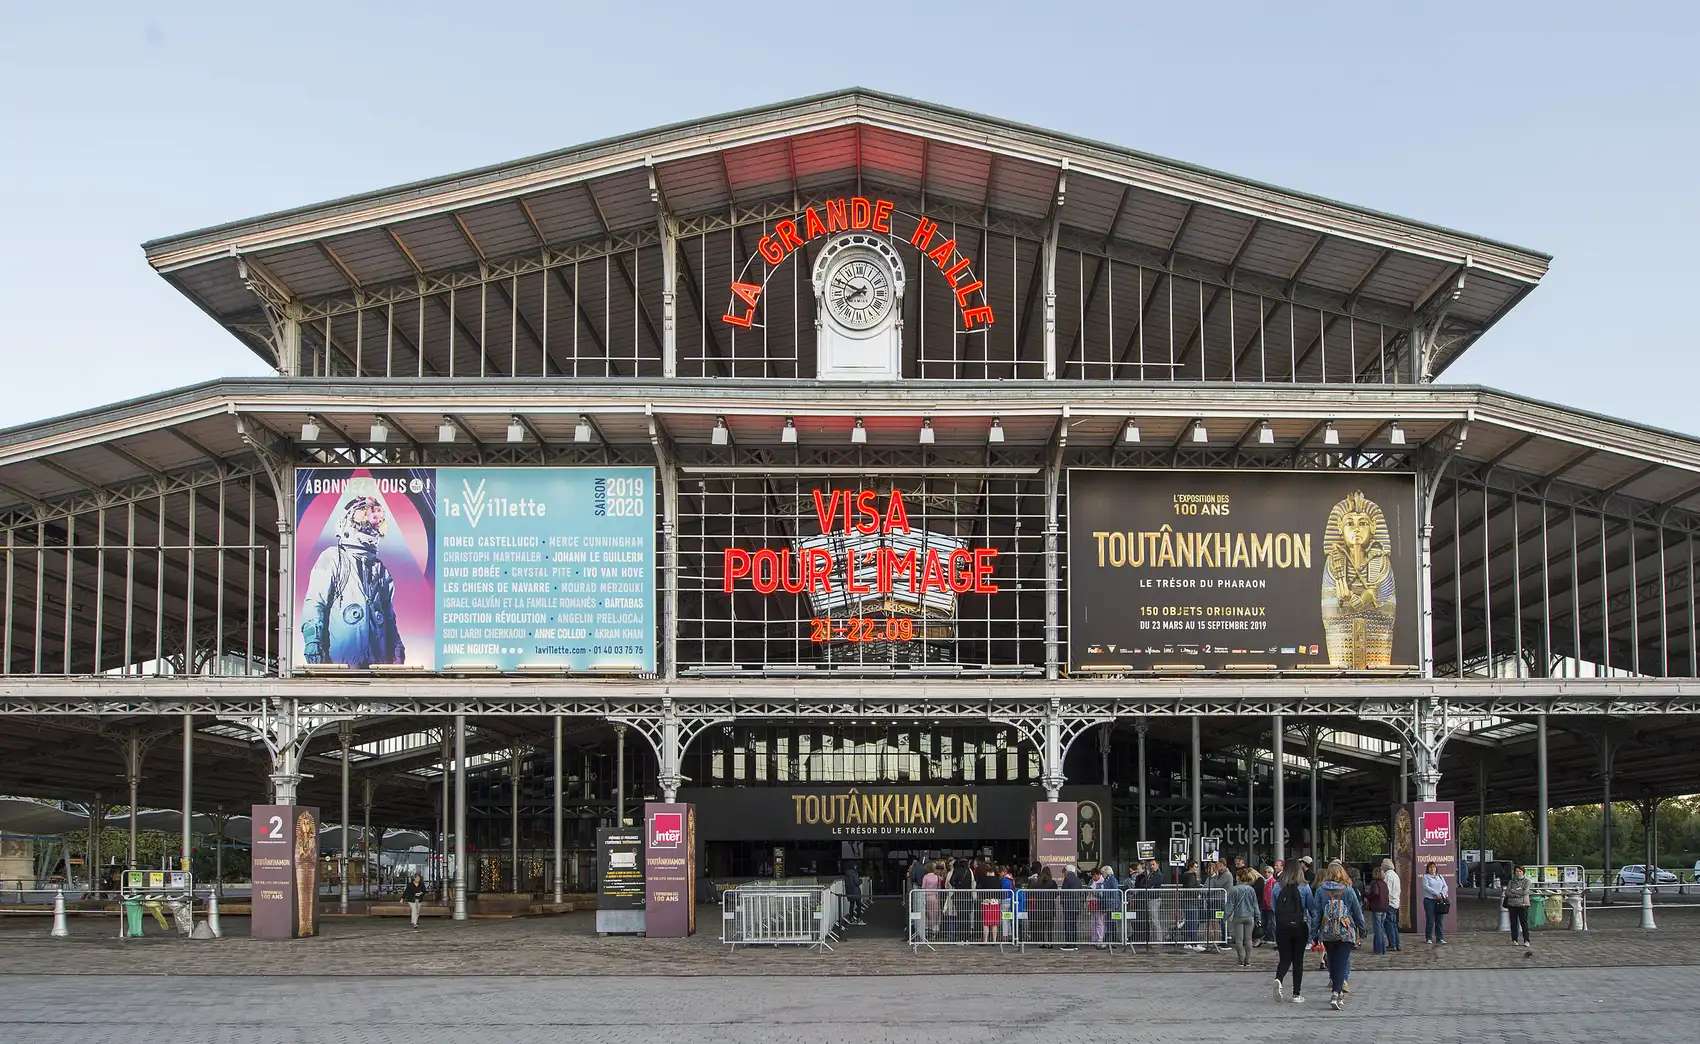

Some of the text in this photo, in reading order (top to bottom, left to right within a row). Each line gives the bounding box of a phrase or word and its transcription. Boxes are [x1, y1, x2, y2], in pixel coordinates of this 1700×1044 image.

[722, 197, 994, 328] LA GRANDE HALLE
[606, 478, 644, 496] 2019
[595, 478, 606, 516] SAISON
[1174, 494, 1229, 503] L'EXPOSITION DES
[606, 498, 644, 516] 2020
[812, 489, 910, 536] VISA
[1174, 504, 1229, 515] 100 ANS
[444, 536, 643, 547] ROMEO CASTELLUCCI MERCE CUNNINGHAM
[1093, 524, 1311, 568] TOUTÂNKHAMON
[444, 552, 643, 562] CHRISTOPH MARTHALER JOHANN LE GUILLERM
[444, 565, 643, 577] DAVID BOBÉE CRYSTAL PITE IVO VAN HOVE
[724, 548, 999, 594] POUR L'IMAGE
[444, 582, 643, 592] LES CHIENS DE NAVARRE MOURAD MERZOUKI
[1140, 577, 1266, 588] LE TRÉSOR DU PHARAON
[444, 598, 470, 608] ISRAEL
[472, 595, 500, 608] GALVÁN
[504, 598, 512, 608] ET
[515, 598, 524, 608] LA
[527, 598, 557, 608] FAMILLE
[605, 598, 643, 608] BARTABAS
[444, 610, 643, 623] EXPOSITION RÉVOLUTION ANGELIN PRELJOCAJ
[1140, 607, 1265, 616] 150 OBJETS ORIGINAUX
[1140, 621, 1266, 629] DU 23 MARS AU 15 SEPTEMBRE 2019
[443, 629, 643, 638] SIDI LARBI CHERKAOUI ANNE COLLOD AKRAM KHAN
[443, 644, 499, 654] ANNE NGUYEN
[535, 646, 643, 654] lavillette.com 01 40 03 75 75
[792, 788, 977, 824] TOUTÂNKHAMON
[269, 816, 283, 838] 2
[1055, 813, 1068, 835] 2
[846, 826, 877, 834] TRÉSOR
[1171, 821, 1290, 845] Biletterie
[1425, 829, 1448, 839] inter
[656, 831, 680, 841] inter
